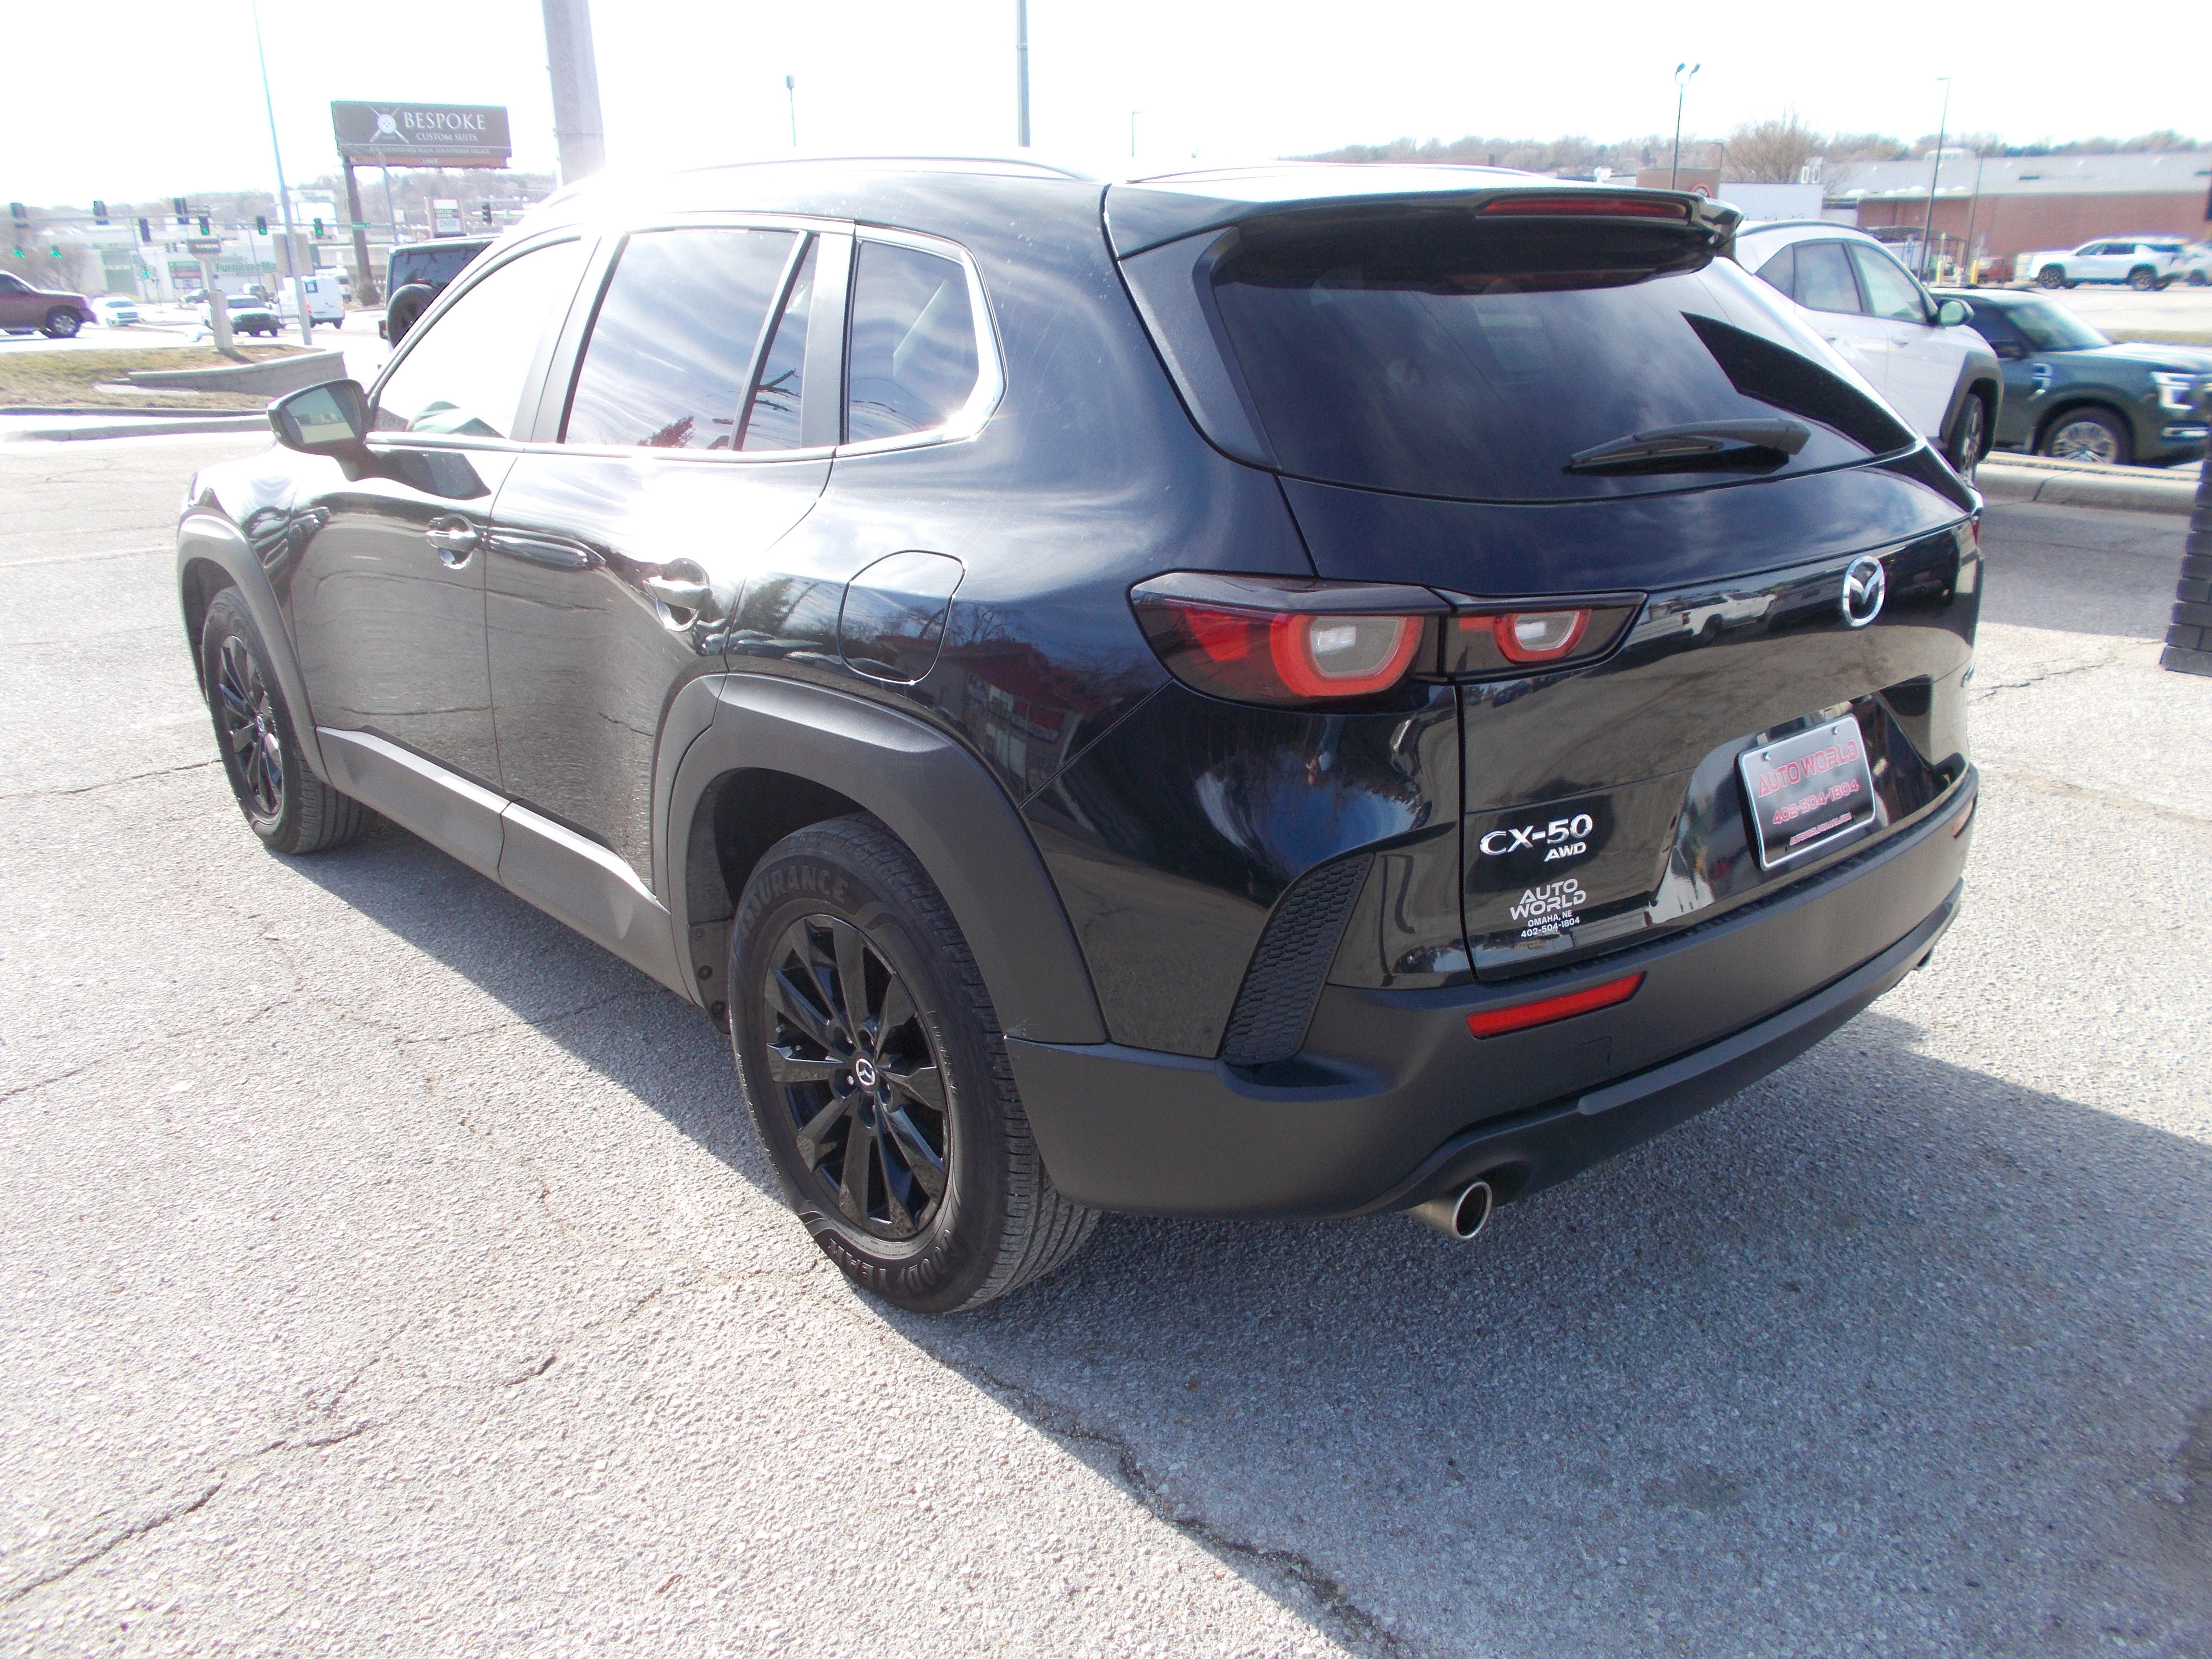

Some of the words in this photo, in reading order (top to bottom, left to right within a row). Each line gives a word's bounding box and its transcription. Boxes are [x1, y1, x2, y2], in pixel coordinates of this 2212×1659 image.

[403, 111, 486, 130] BESPOKE
[416, 132, 453, 141] CUSTOM
[455, 133, 477, 142] SUITS
[1758, 761, 1800, 798] AUTO
[1800, 739, 1860, 778] WORLD
[1772, 778, 1860, 825] 402-504-1804
[1480, 814, 1593, 855] CX-50
[1544, 842, 1586, 862] AWD
[1519, 878, 1578, 904] AUTO
[1510, 890, 1586, 920] WORLD
[1521, 916, 1580, 938] 402-504-1804
[1528, 914, 1562, 927] OMAHA,
[1562, 910, 1572, 918] NE
